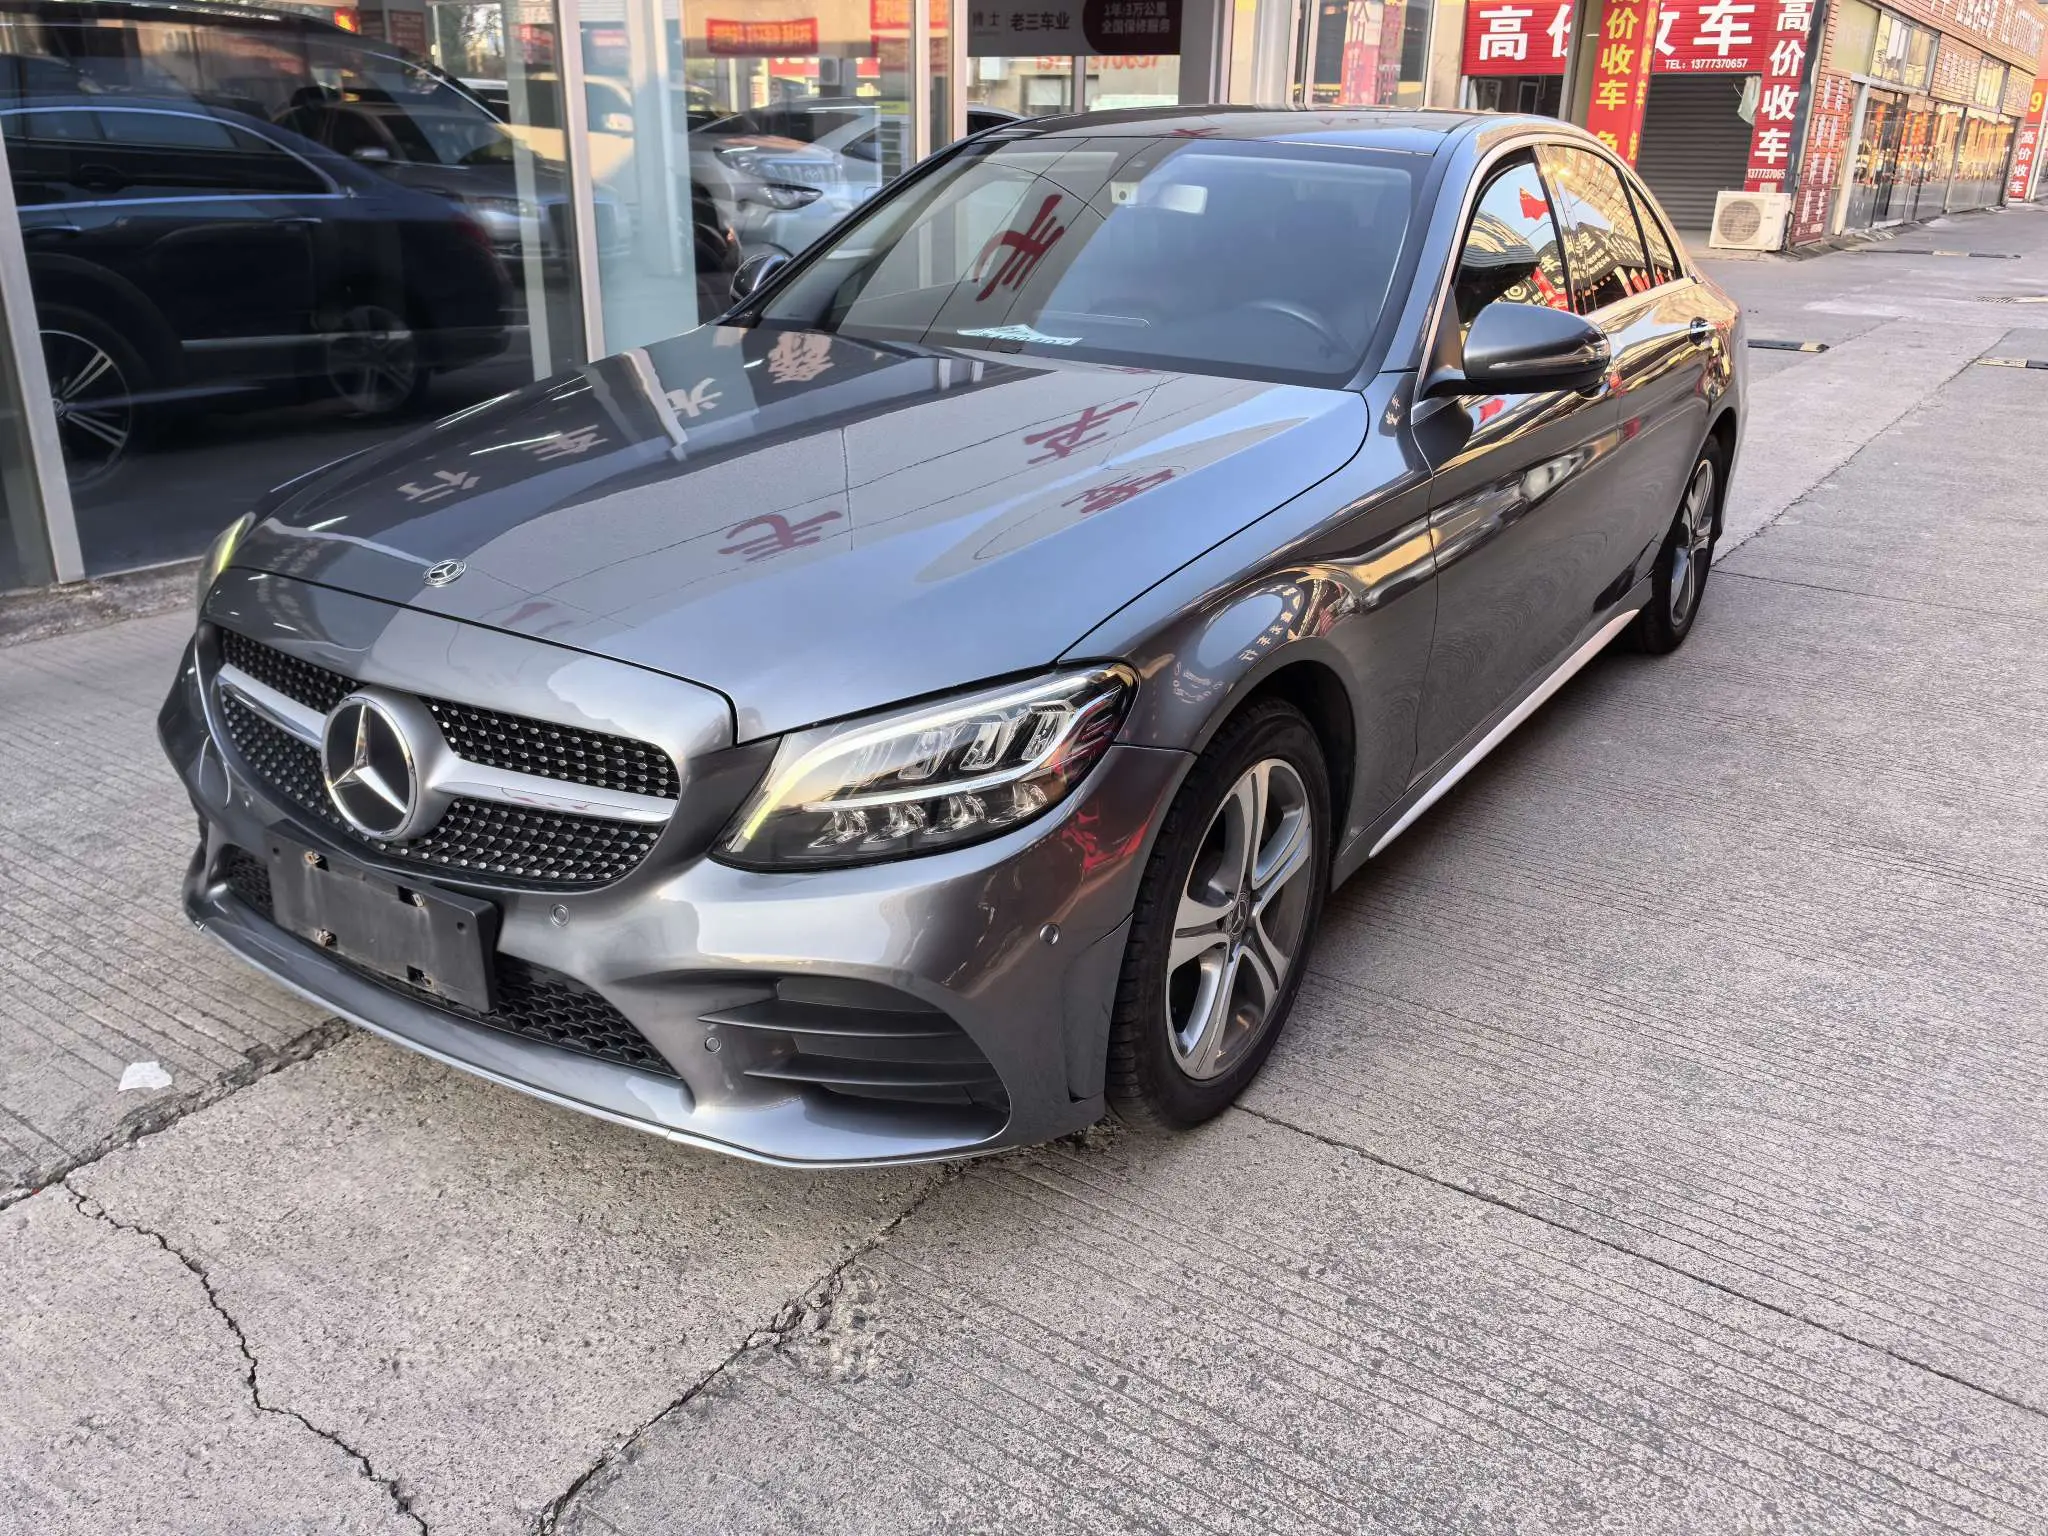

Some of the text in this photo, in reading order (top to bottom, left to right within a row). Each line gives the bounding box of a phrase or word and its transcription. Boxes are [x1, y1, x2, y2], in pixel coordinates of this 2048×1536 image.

[1010, 11, 1070, 32] 老三车业
[1596, 0, 1642, 111] 价收车
[1691, 58, 1748, 70] 13777370657
[1754, 0, 1811, 165] 高价收车
[2009, 130, 2036, 194] 高价收车
